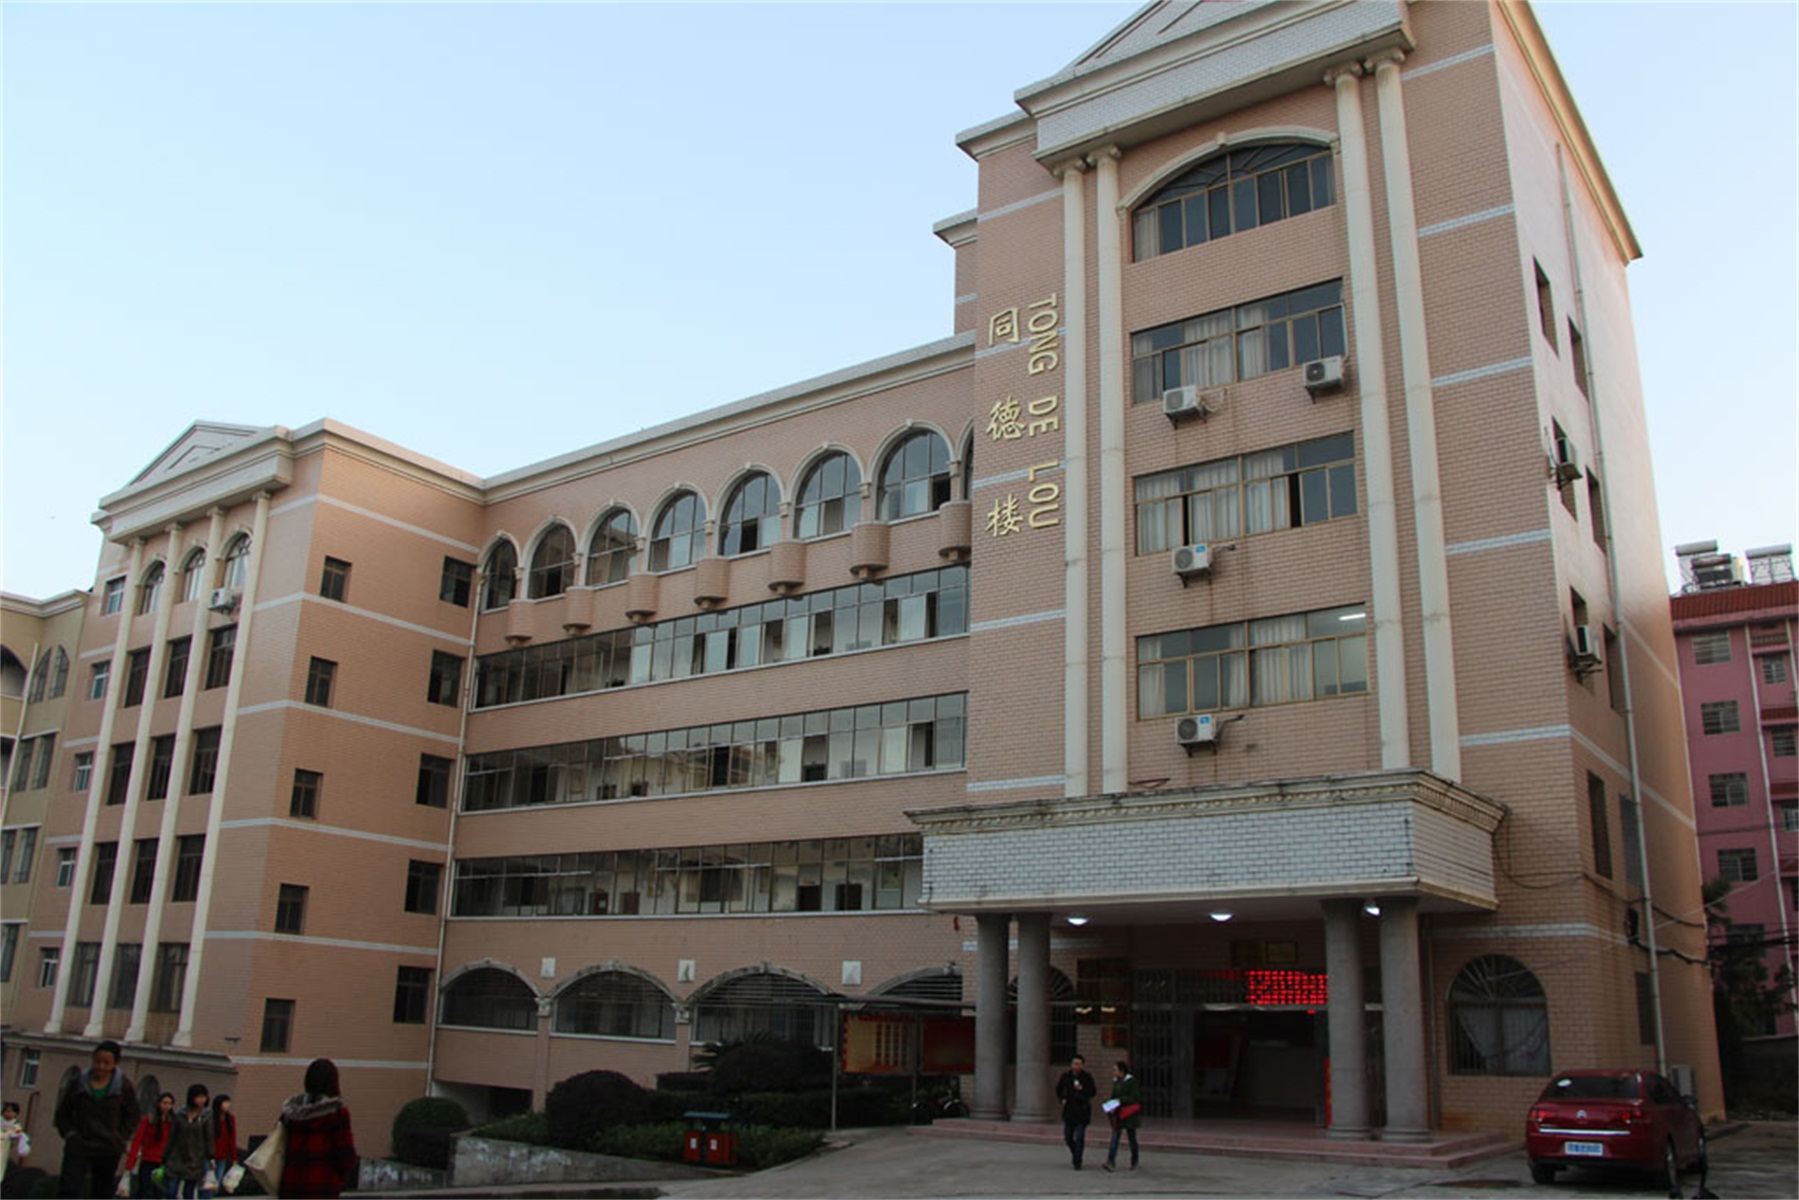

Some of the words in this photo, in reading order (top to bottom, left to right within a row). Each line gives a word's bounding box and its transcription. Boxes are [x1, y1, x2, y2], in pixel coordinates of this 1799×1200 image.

[1028, 292, 1058, 375] TONG
[985, 307, 1027, 537] 同德楼
[1028, 396, 1059, 437] DE
[1028, 459, 1060, 529] LOU
